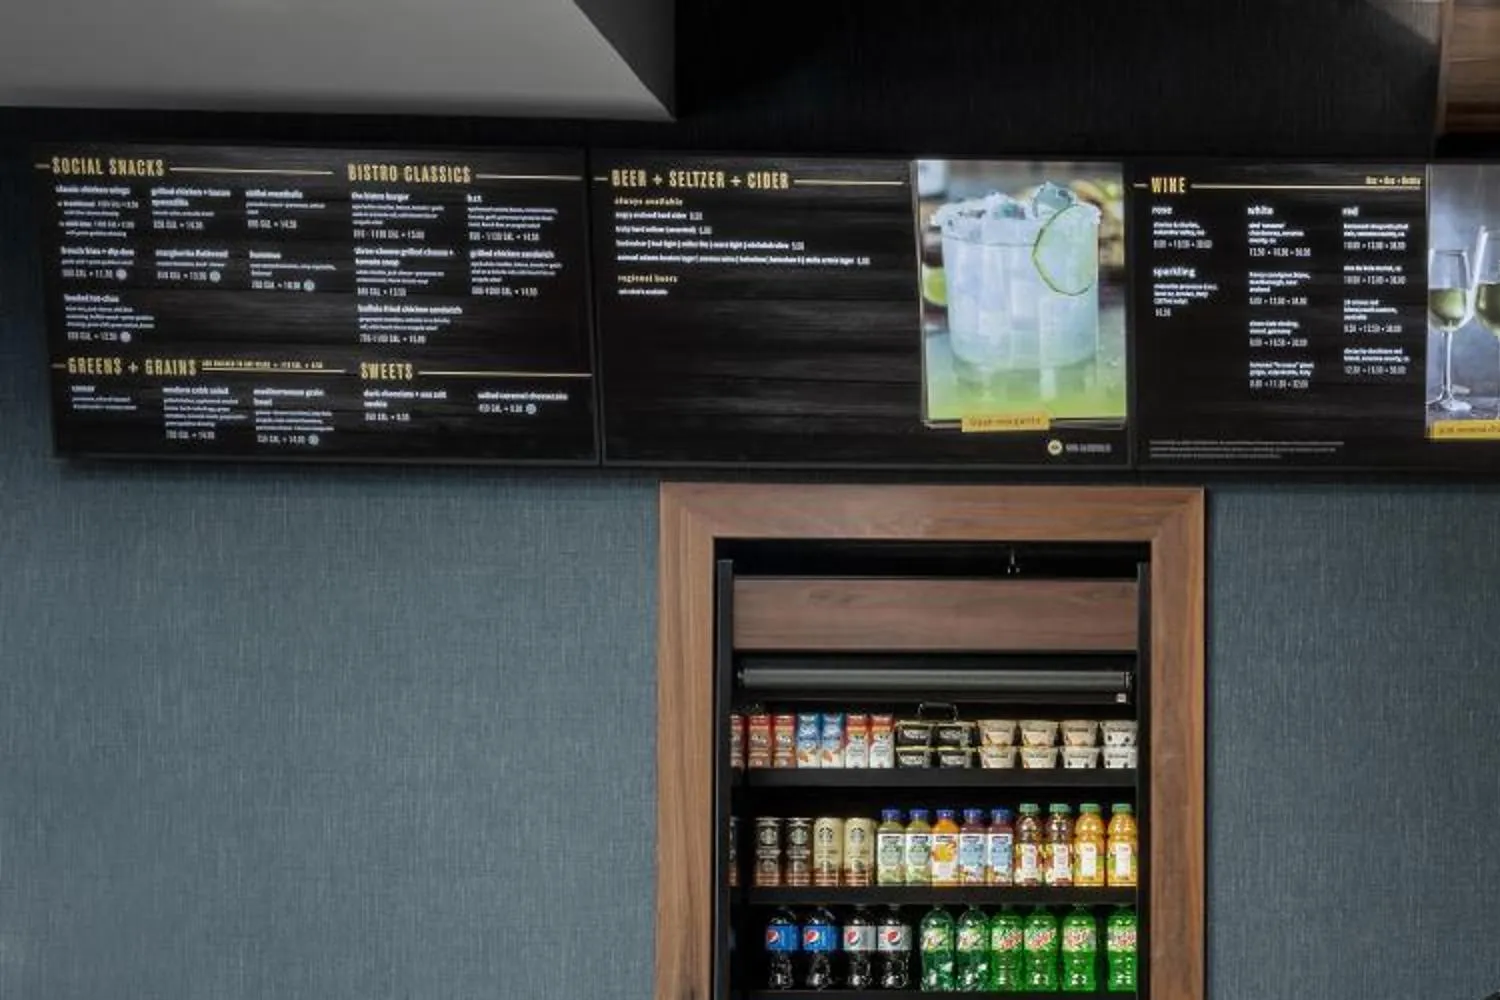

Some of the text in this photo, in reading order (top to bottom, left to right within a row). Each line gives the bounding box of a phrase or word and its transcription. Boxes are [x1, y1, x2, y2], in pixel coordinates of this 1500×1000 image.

[52, 157, 165, 176] SOCIAL SNACKS
[347, 164, 471, 184] BISTRO CLASSICS
[611, 169, 647, 187] BEER
[669, 170, 725, 188] SELTZER
[747, 172, 789, 189] CIDER
[1151, 177, 1185, 193] WINE
[68, 357, 122, 375] GREENS
[145, 359, 196, 376] GRAINS
[360, 362, 413, 379] SWEETS
